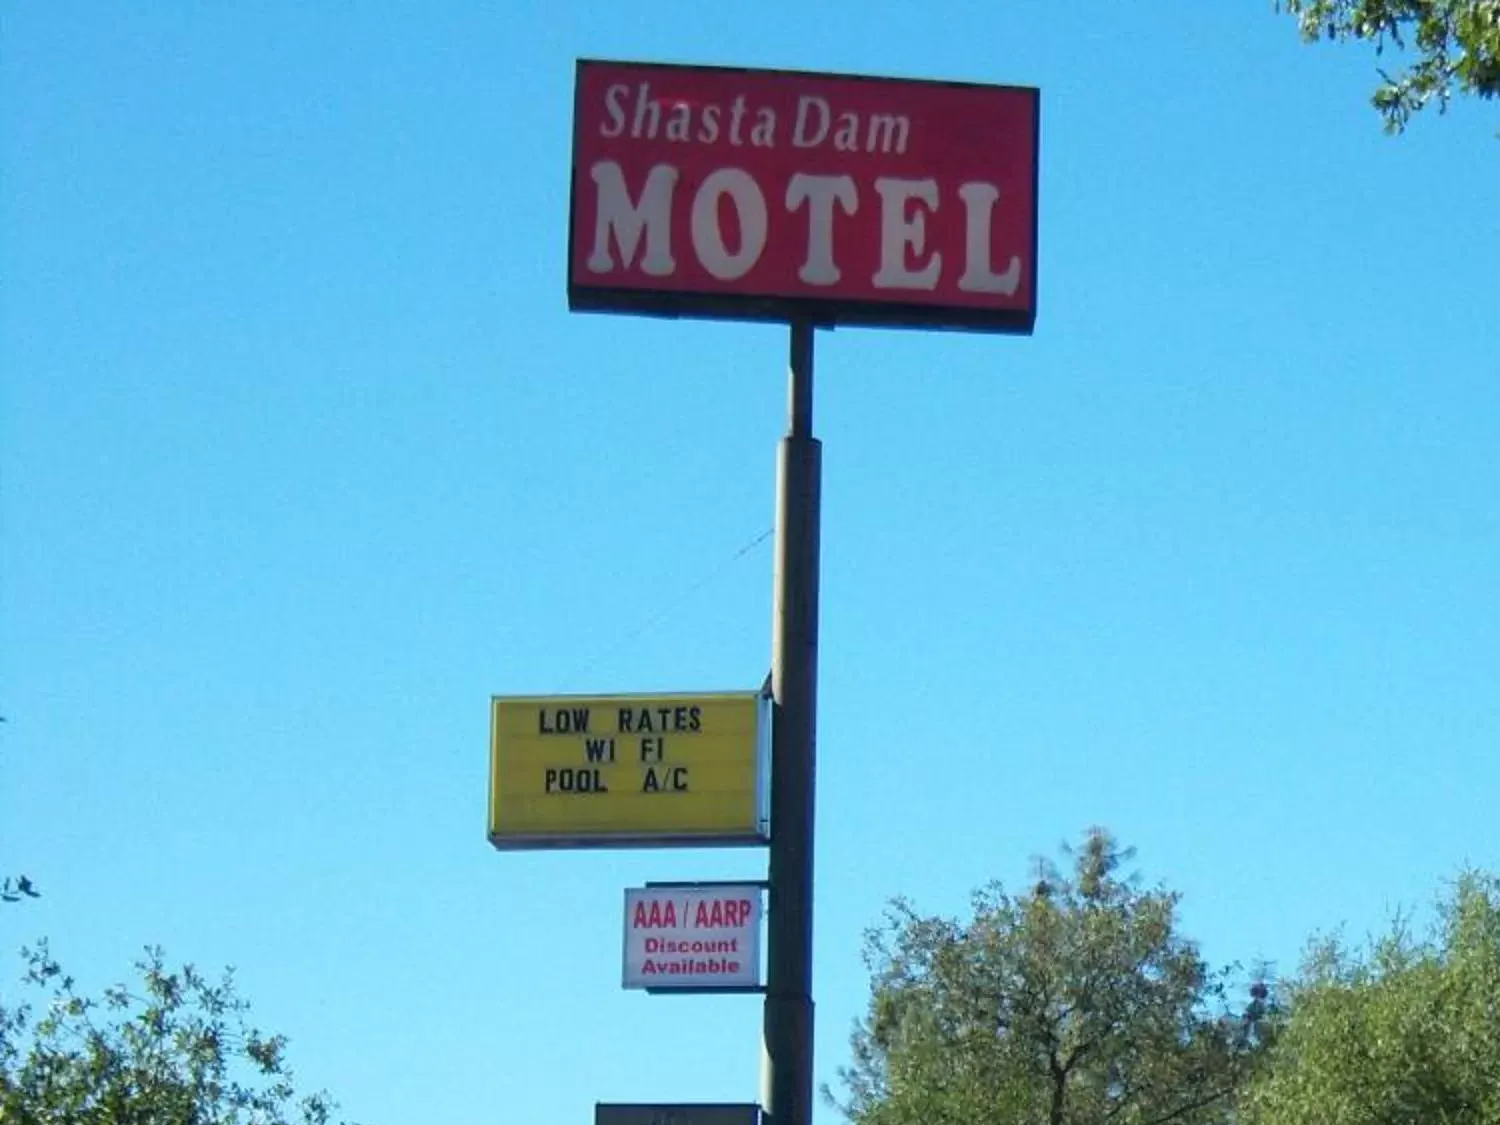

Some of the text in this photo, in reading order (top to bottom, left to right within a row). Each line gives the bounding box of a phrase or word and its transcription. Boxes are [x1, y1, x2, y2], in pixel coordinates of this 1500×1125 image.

[600, 82, 910, 154] Shasta Dam
[586, 160, 1022, 295] MOTEL
[539, 707, 702, 734] LOW RATES
[586, 738, 664, 762] WI FI
[545, 768, 689, 793] POOL A/C
[645, 938, 738, 953] Discount
[642, 958, 740, 975] Available
